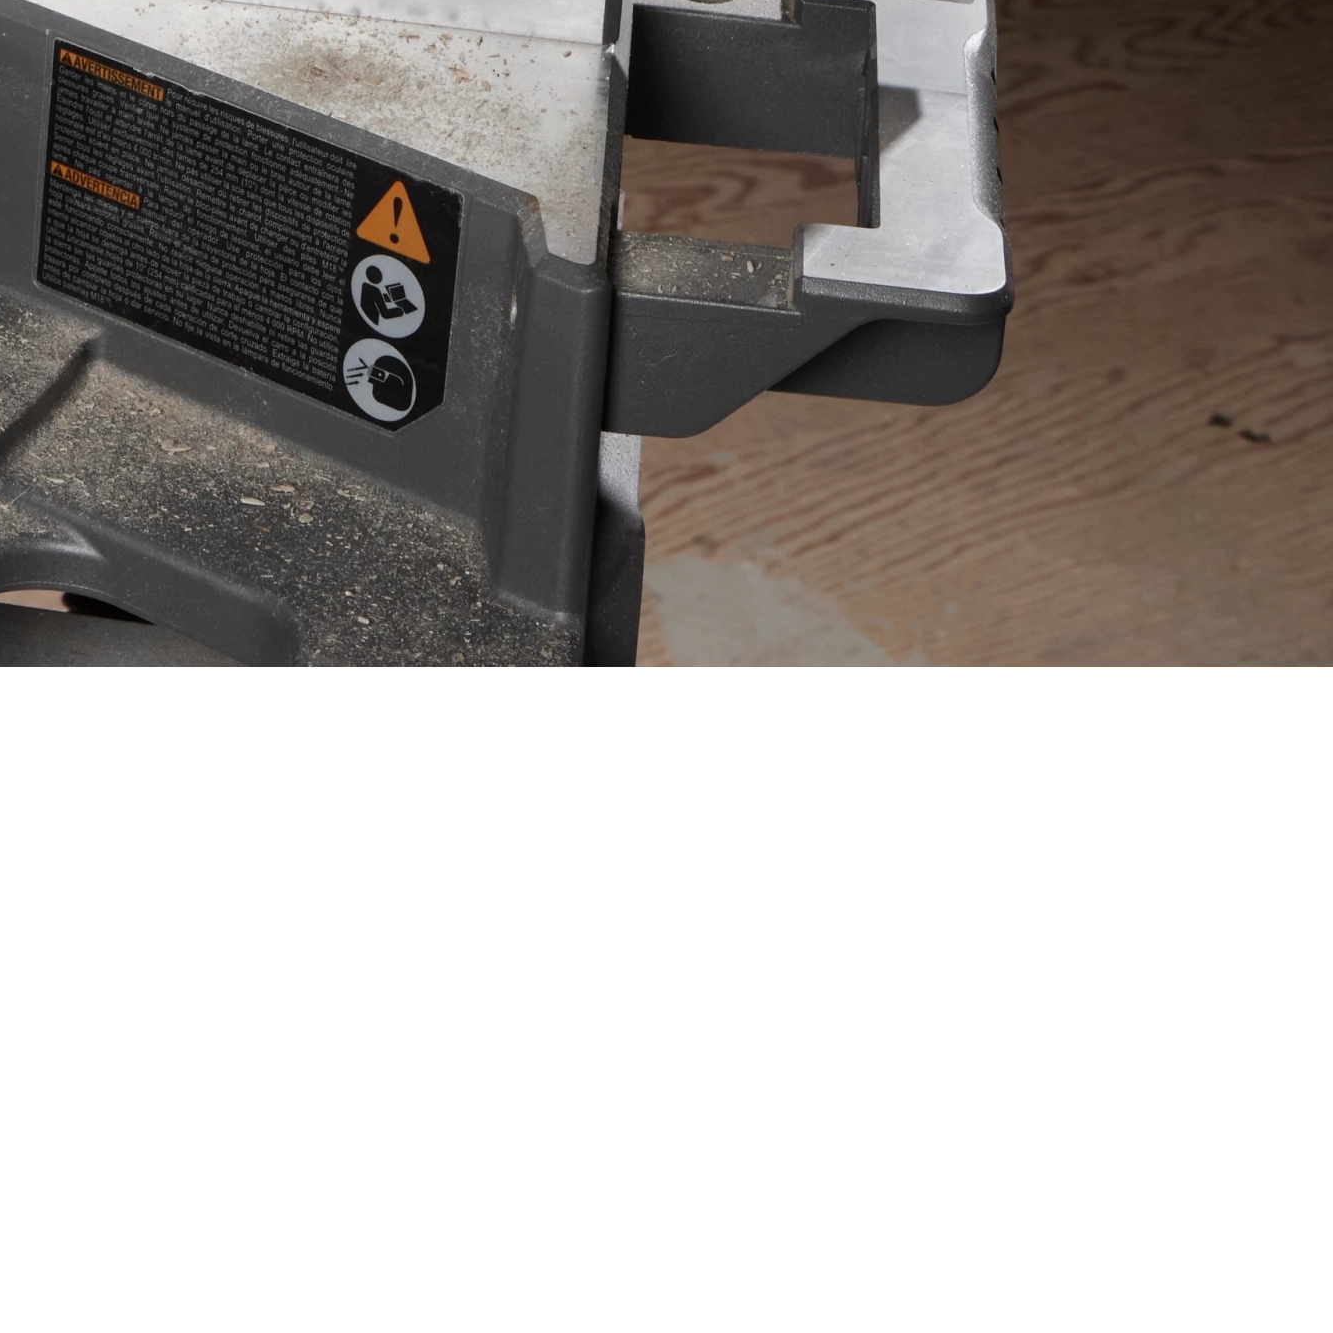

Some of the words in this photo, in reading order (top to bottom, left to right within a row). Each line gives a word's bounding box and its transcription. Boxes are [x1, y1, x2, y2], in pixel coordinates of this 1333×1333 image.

[74, 55, 161, 99] AVERTISSEMENT
[220, 110, 244, 125] risques
[246, 119, 254, 129] de
[65, 168, 138, 207] ADVERTENCIA
[187, 216, 193, 224] el
[220, 228, 228, 238] de
[302, 262, 319, 276] debe
[226, 241, 240, 253] Use
[289, 268, 305, 279] para
[311, 275, 321, 286] los
